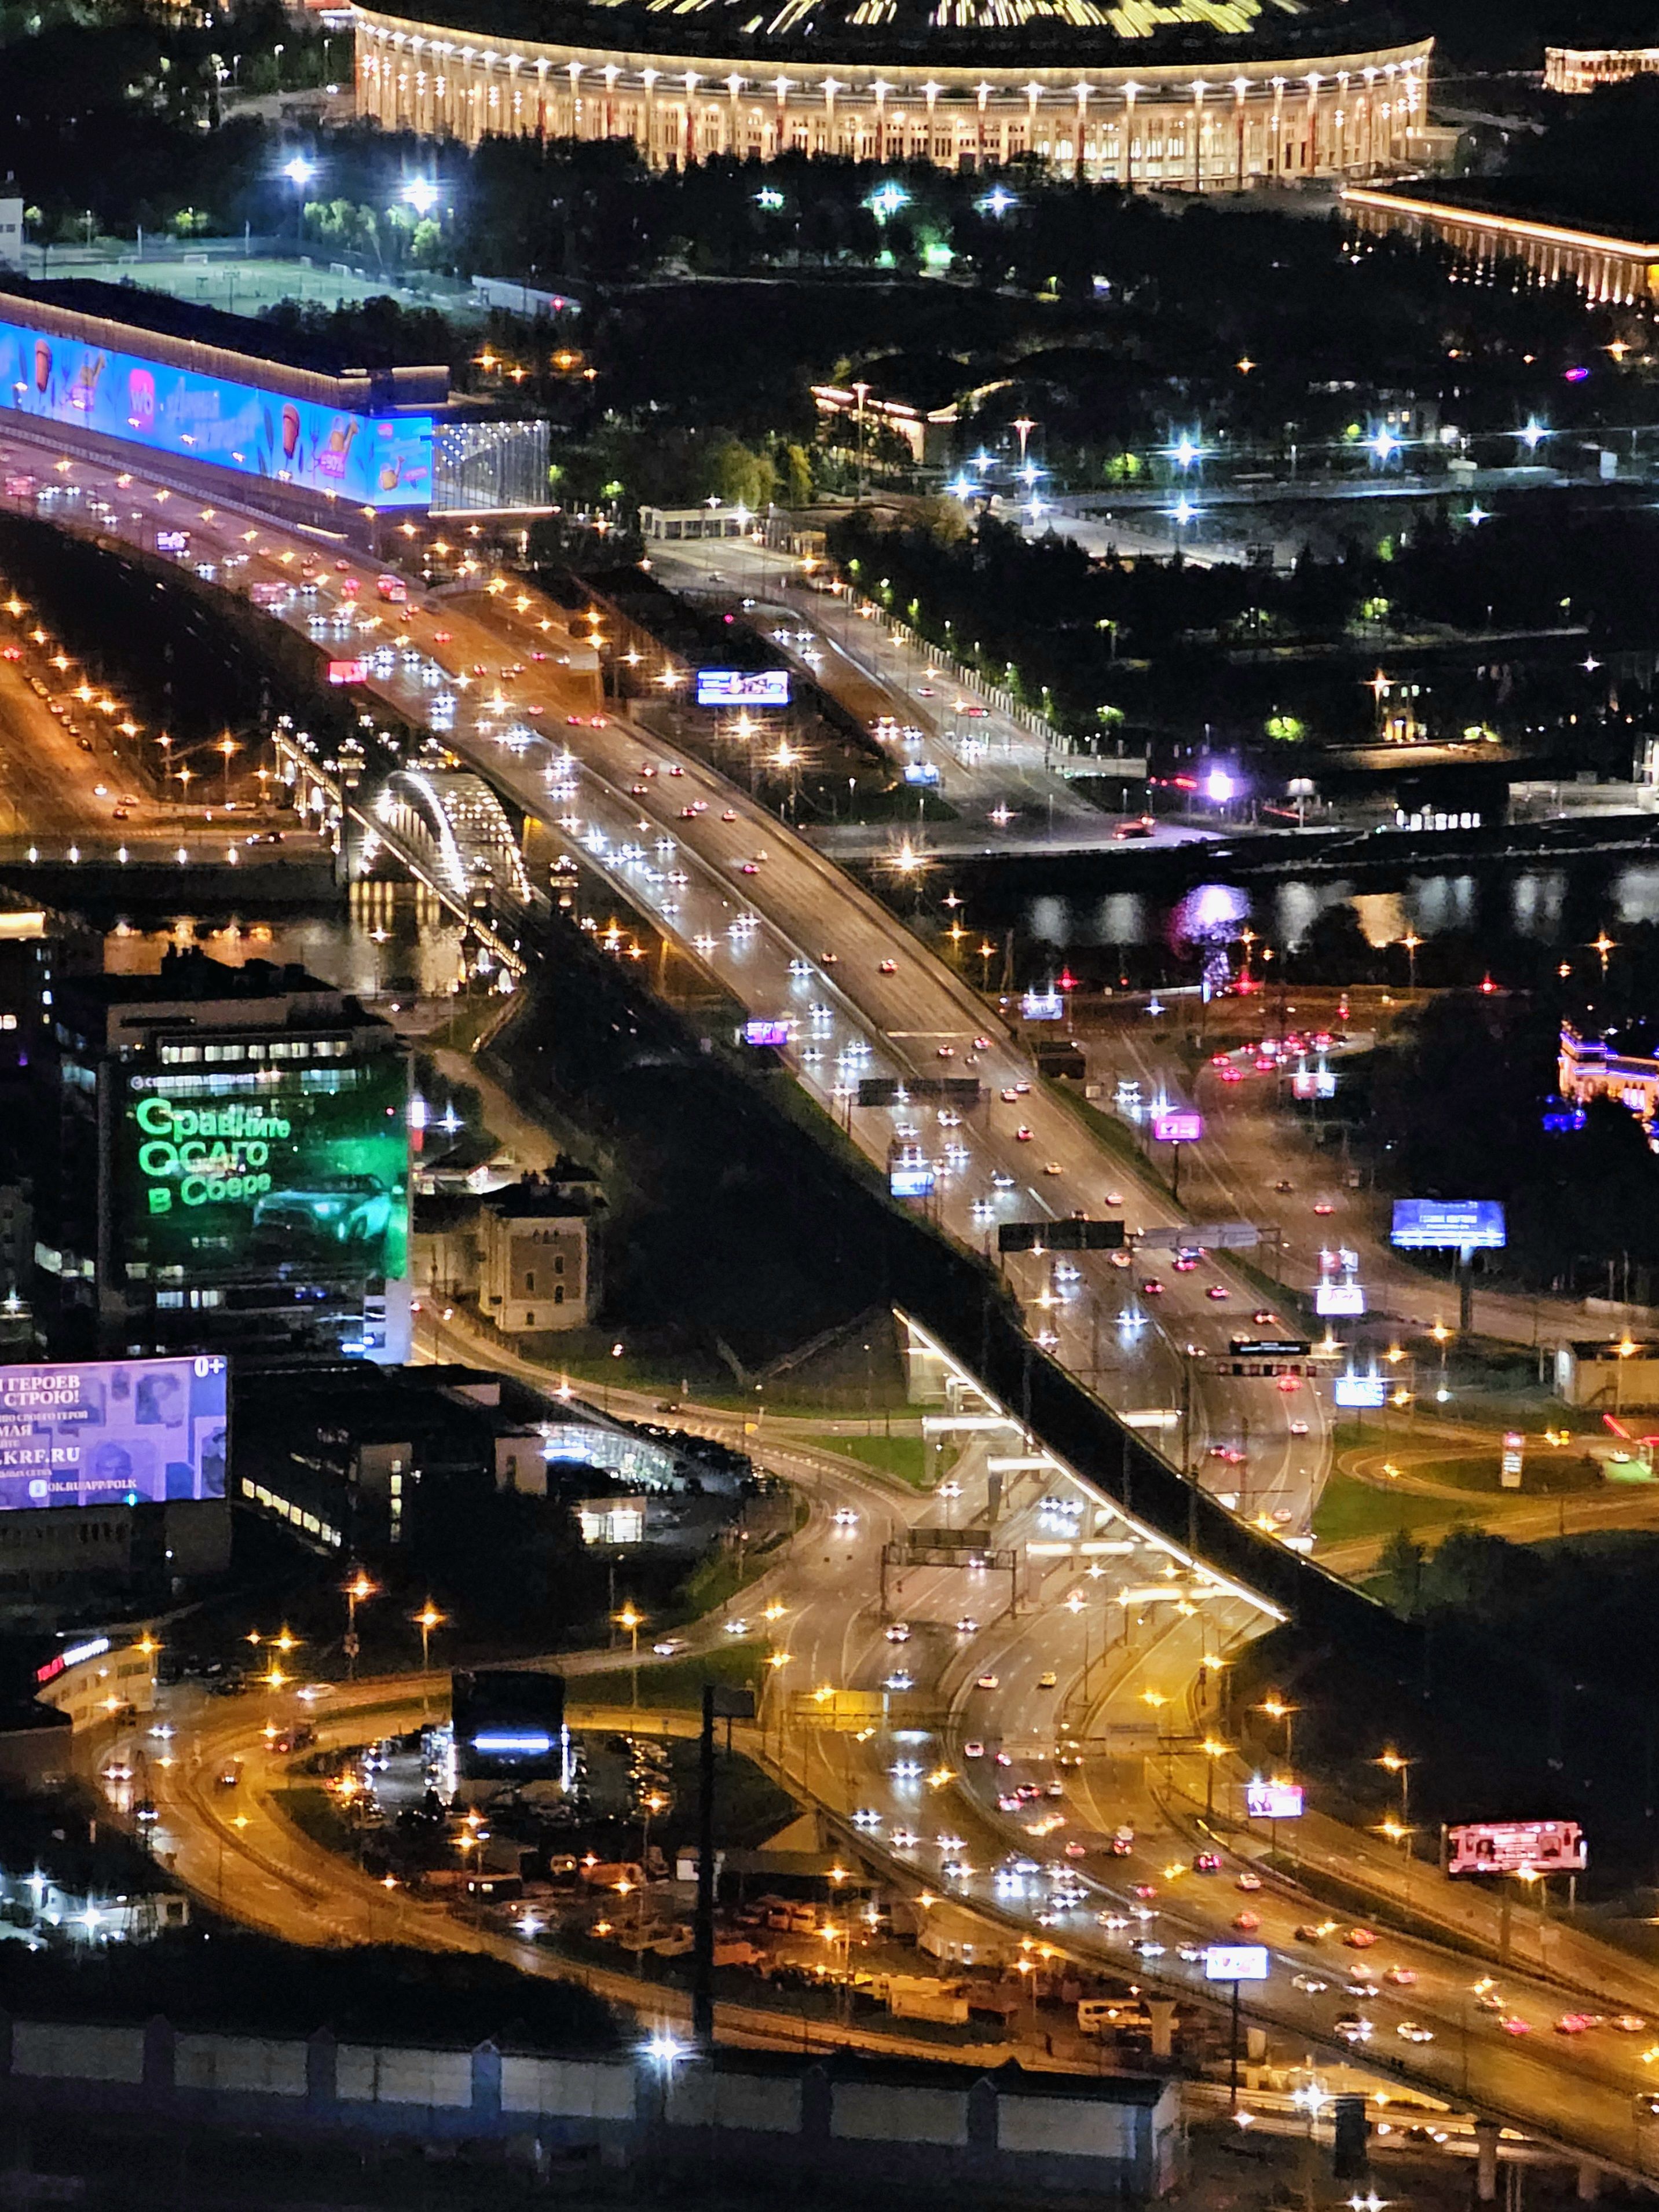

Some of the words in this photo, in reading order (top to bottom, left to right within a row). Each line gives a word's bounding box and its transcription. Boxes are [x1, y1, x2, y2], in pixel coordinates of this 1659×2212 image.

[137, 1098, 290, 1142] Сравните
[139, 1141, 268, 1175] ОСАГО
[195, 1358, 224, 1377] 0+
[8, 1375, 80, 1391] ГЕРОЕВ
[4, 1390, 80, 1407] СТРОЮ!
